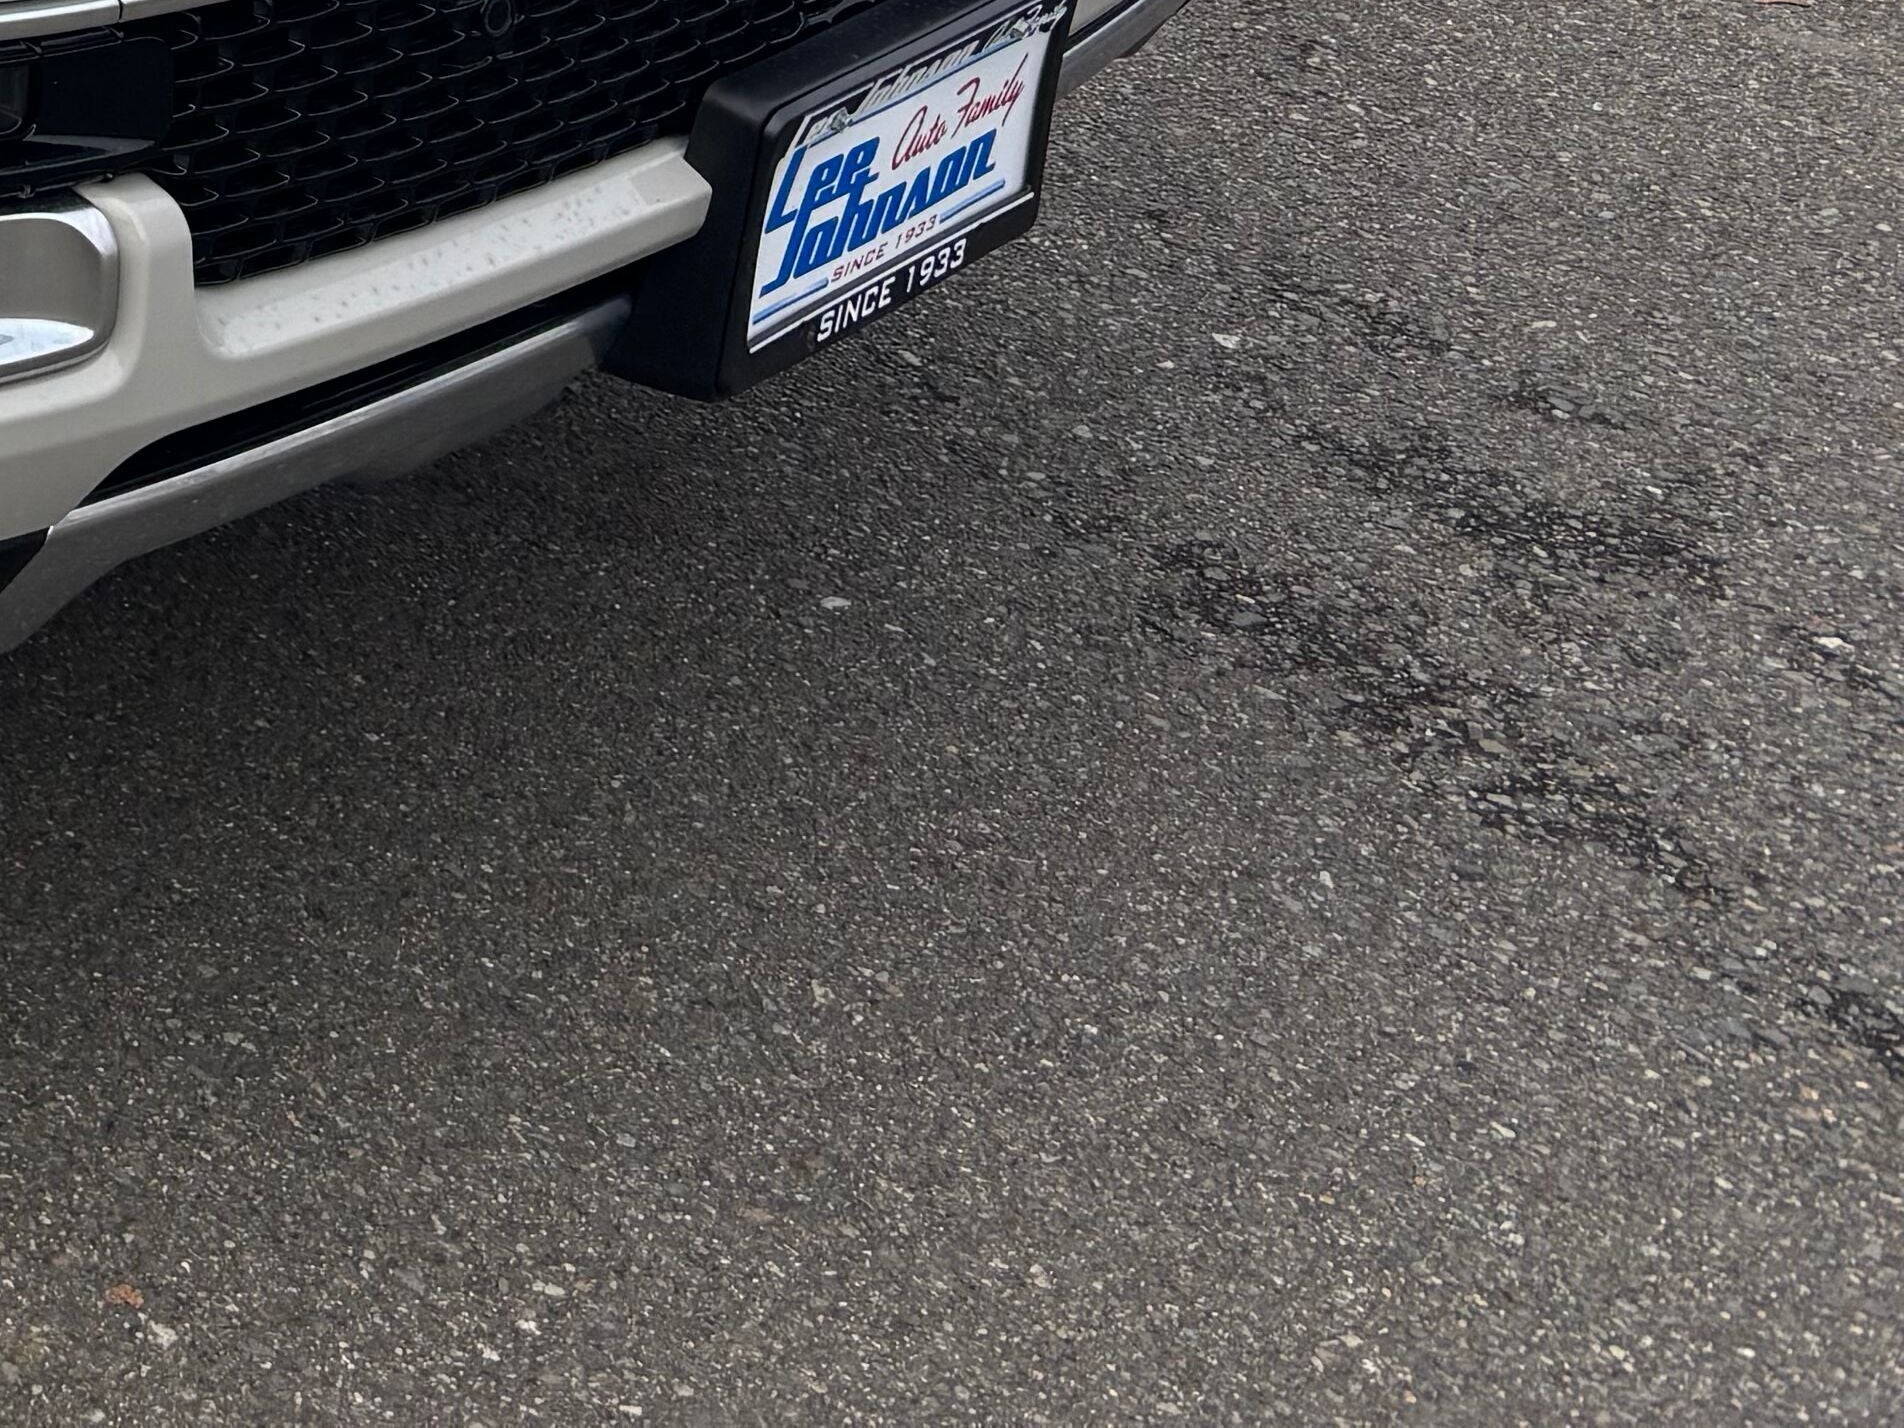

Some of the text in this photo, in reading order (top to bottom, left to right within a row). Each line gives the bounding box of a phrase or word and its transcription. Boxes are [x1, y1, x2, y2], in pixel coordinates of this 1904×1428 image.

[765, 52, 1029, 234] Lee Auto Family
[759, 129, 997, 297] Johnson
[830, 213, 938, 283] SINCE 1933
[816, 237, 967, 343] SINCE 1933
